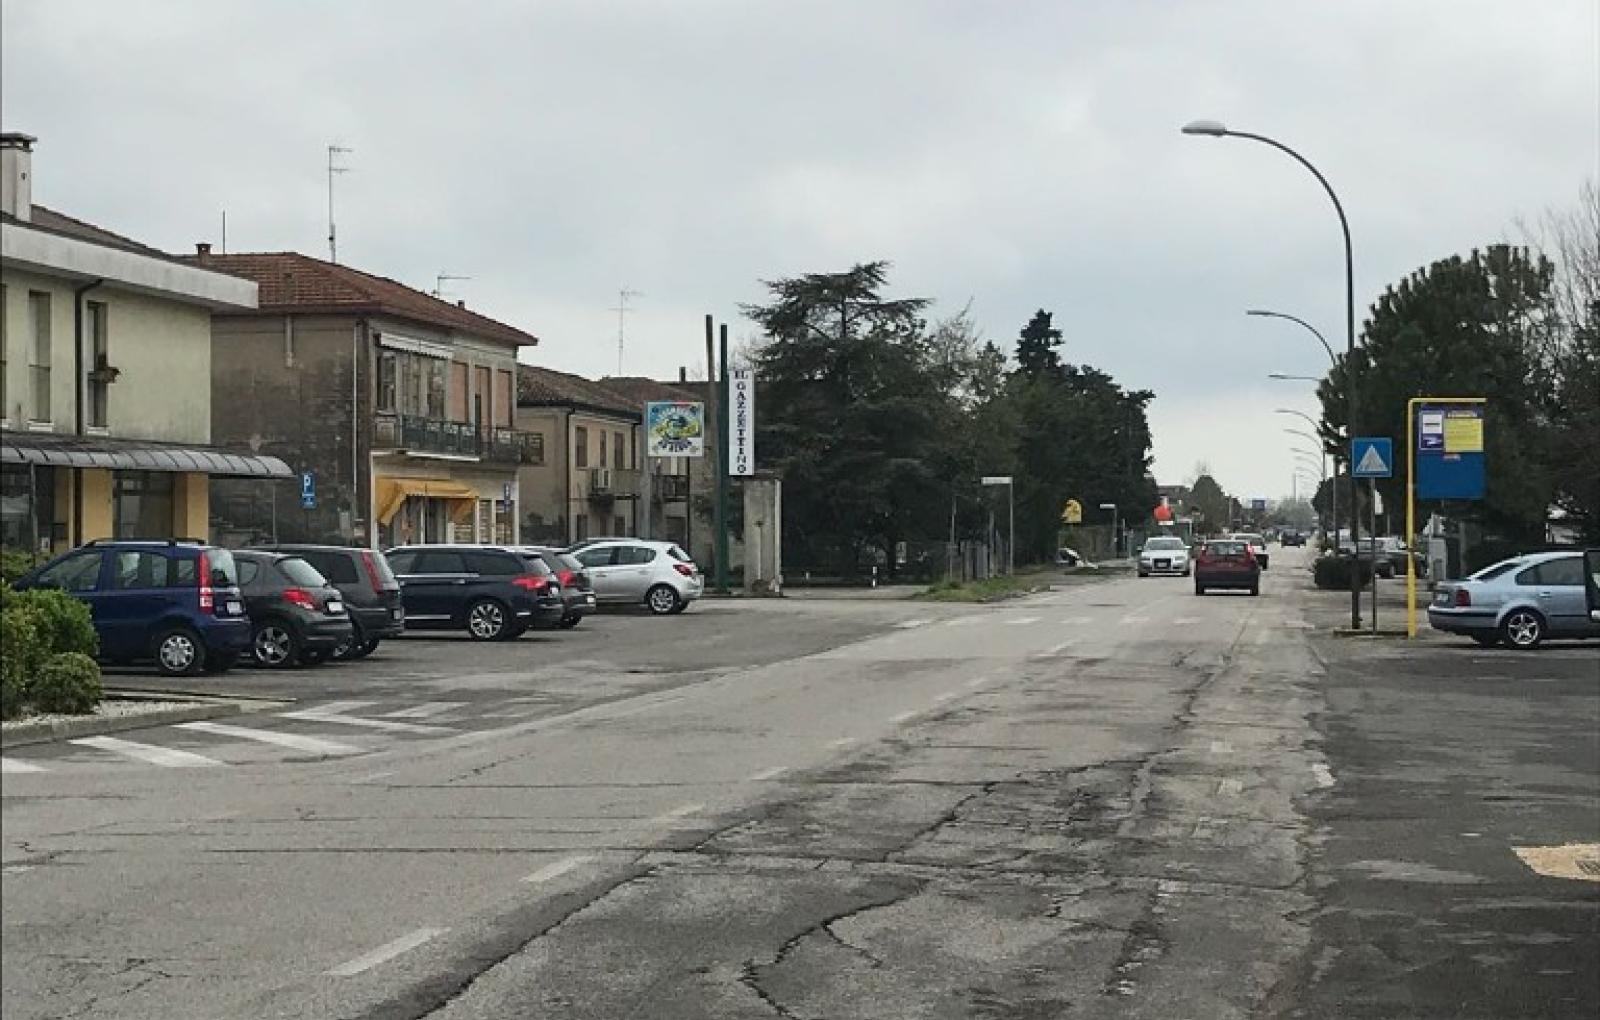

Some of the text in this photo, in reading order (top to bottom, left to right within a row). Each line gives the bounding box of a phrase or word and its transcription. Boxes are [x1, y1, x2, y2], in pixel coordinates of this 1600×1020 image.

[735, 371, 748, 379] IL
[737, 381, 746, 473] GAZZETTINO
[304, 474, 311, 493] P
